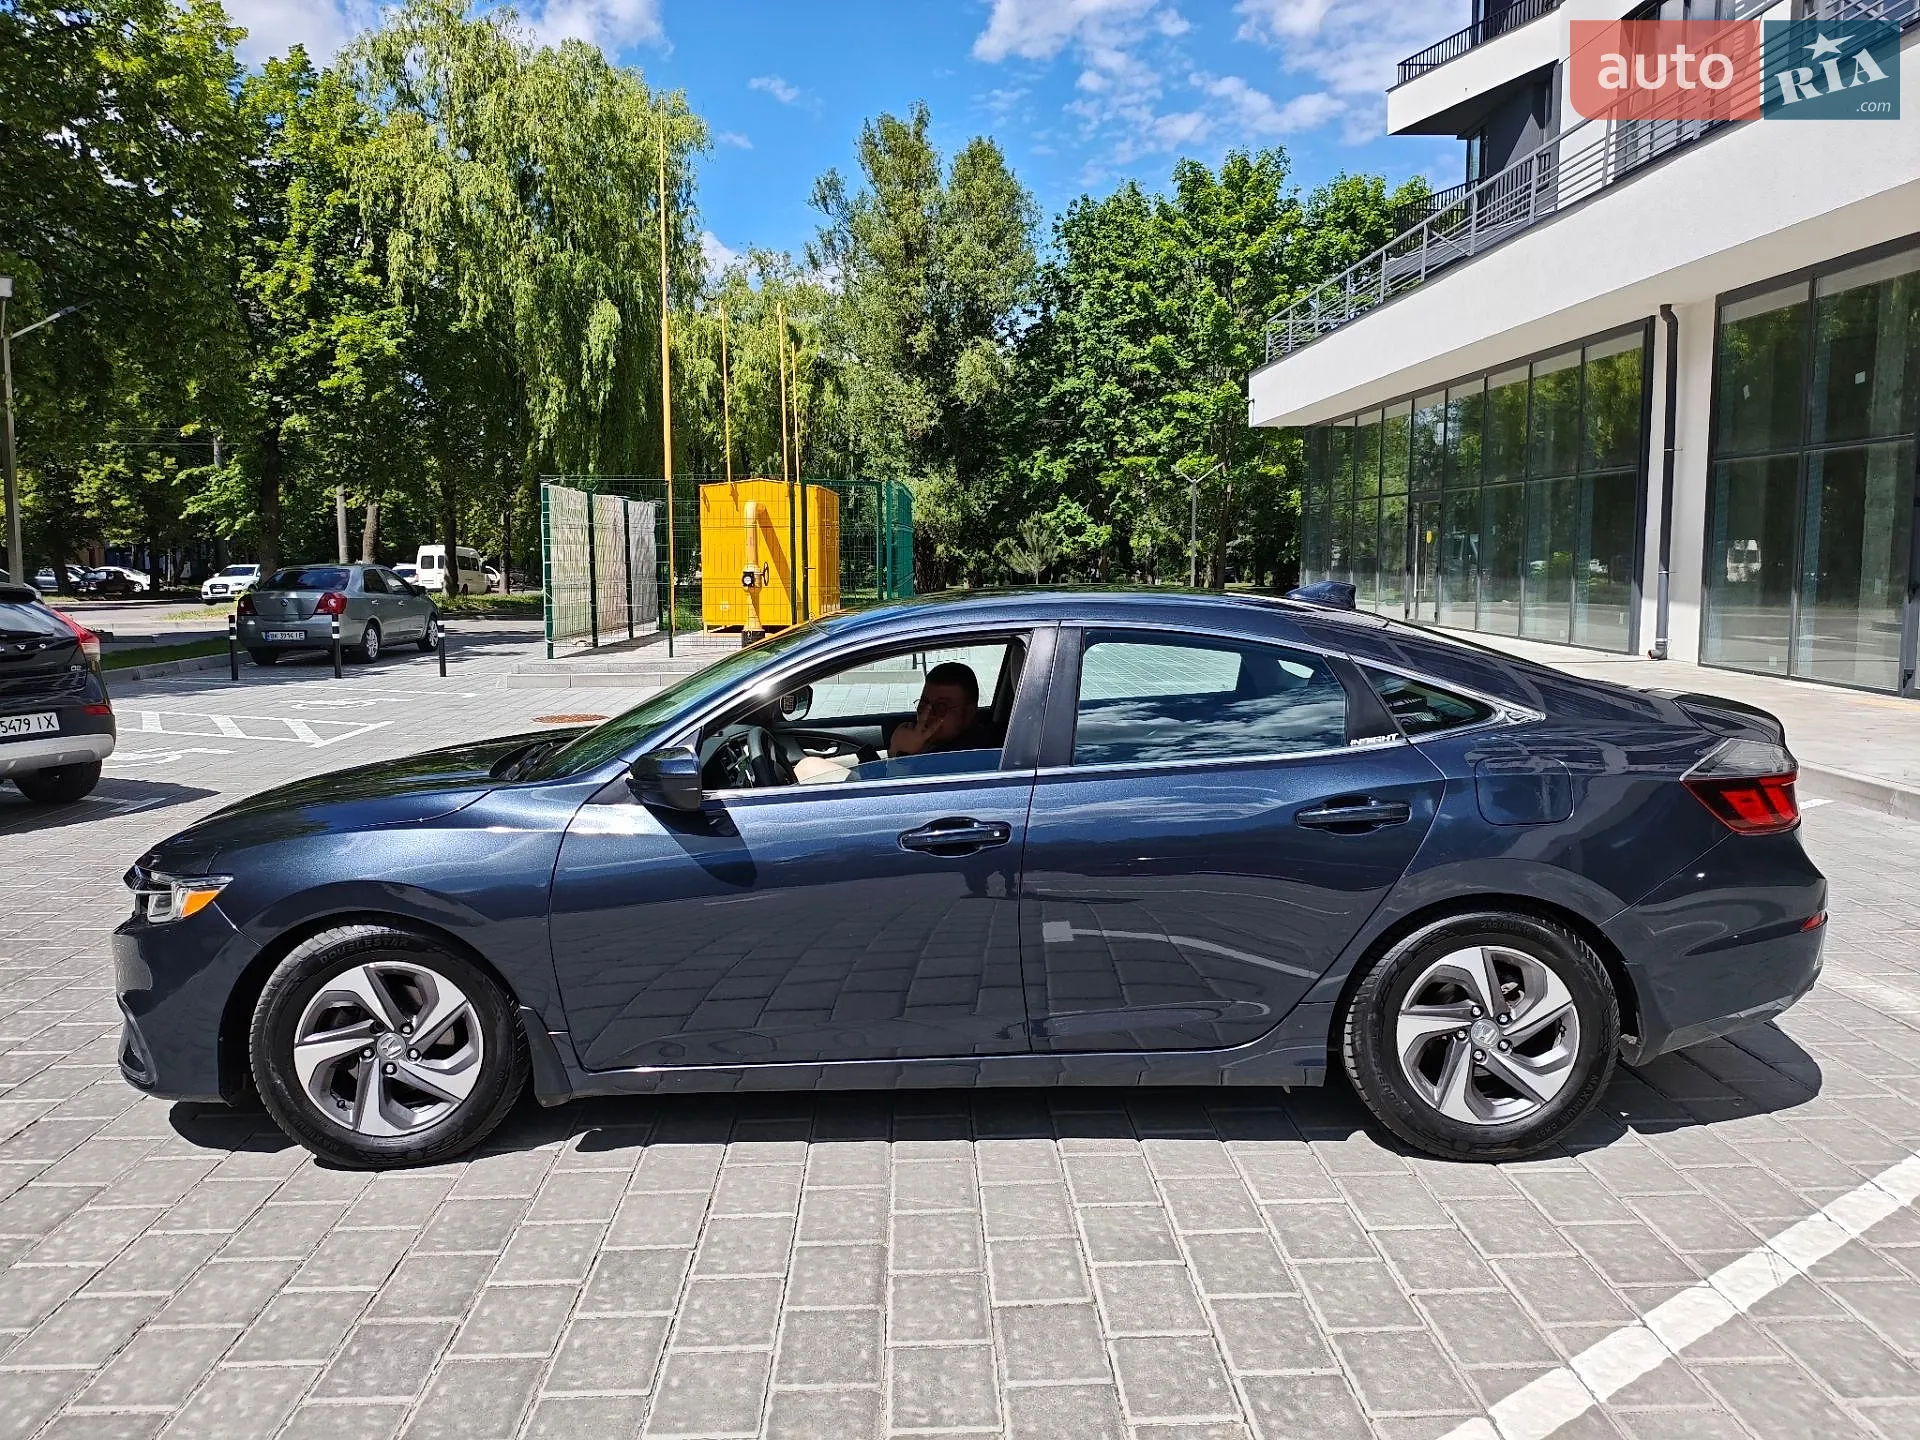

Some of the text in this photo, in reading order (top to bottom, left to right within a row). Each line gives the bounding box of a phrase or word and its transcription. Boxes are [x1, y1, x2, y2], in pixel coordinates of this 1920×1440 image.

[0, 715, 56, 734] 5479 IX
[319, 936, 409, 965] DOUBLESTAR
